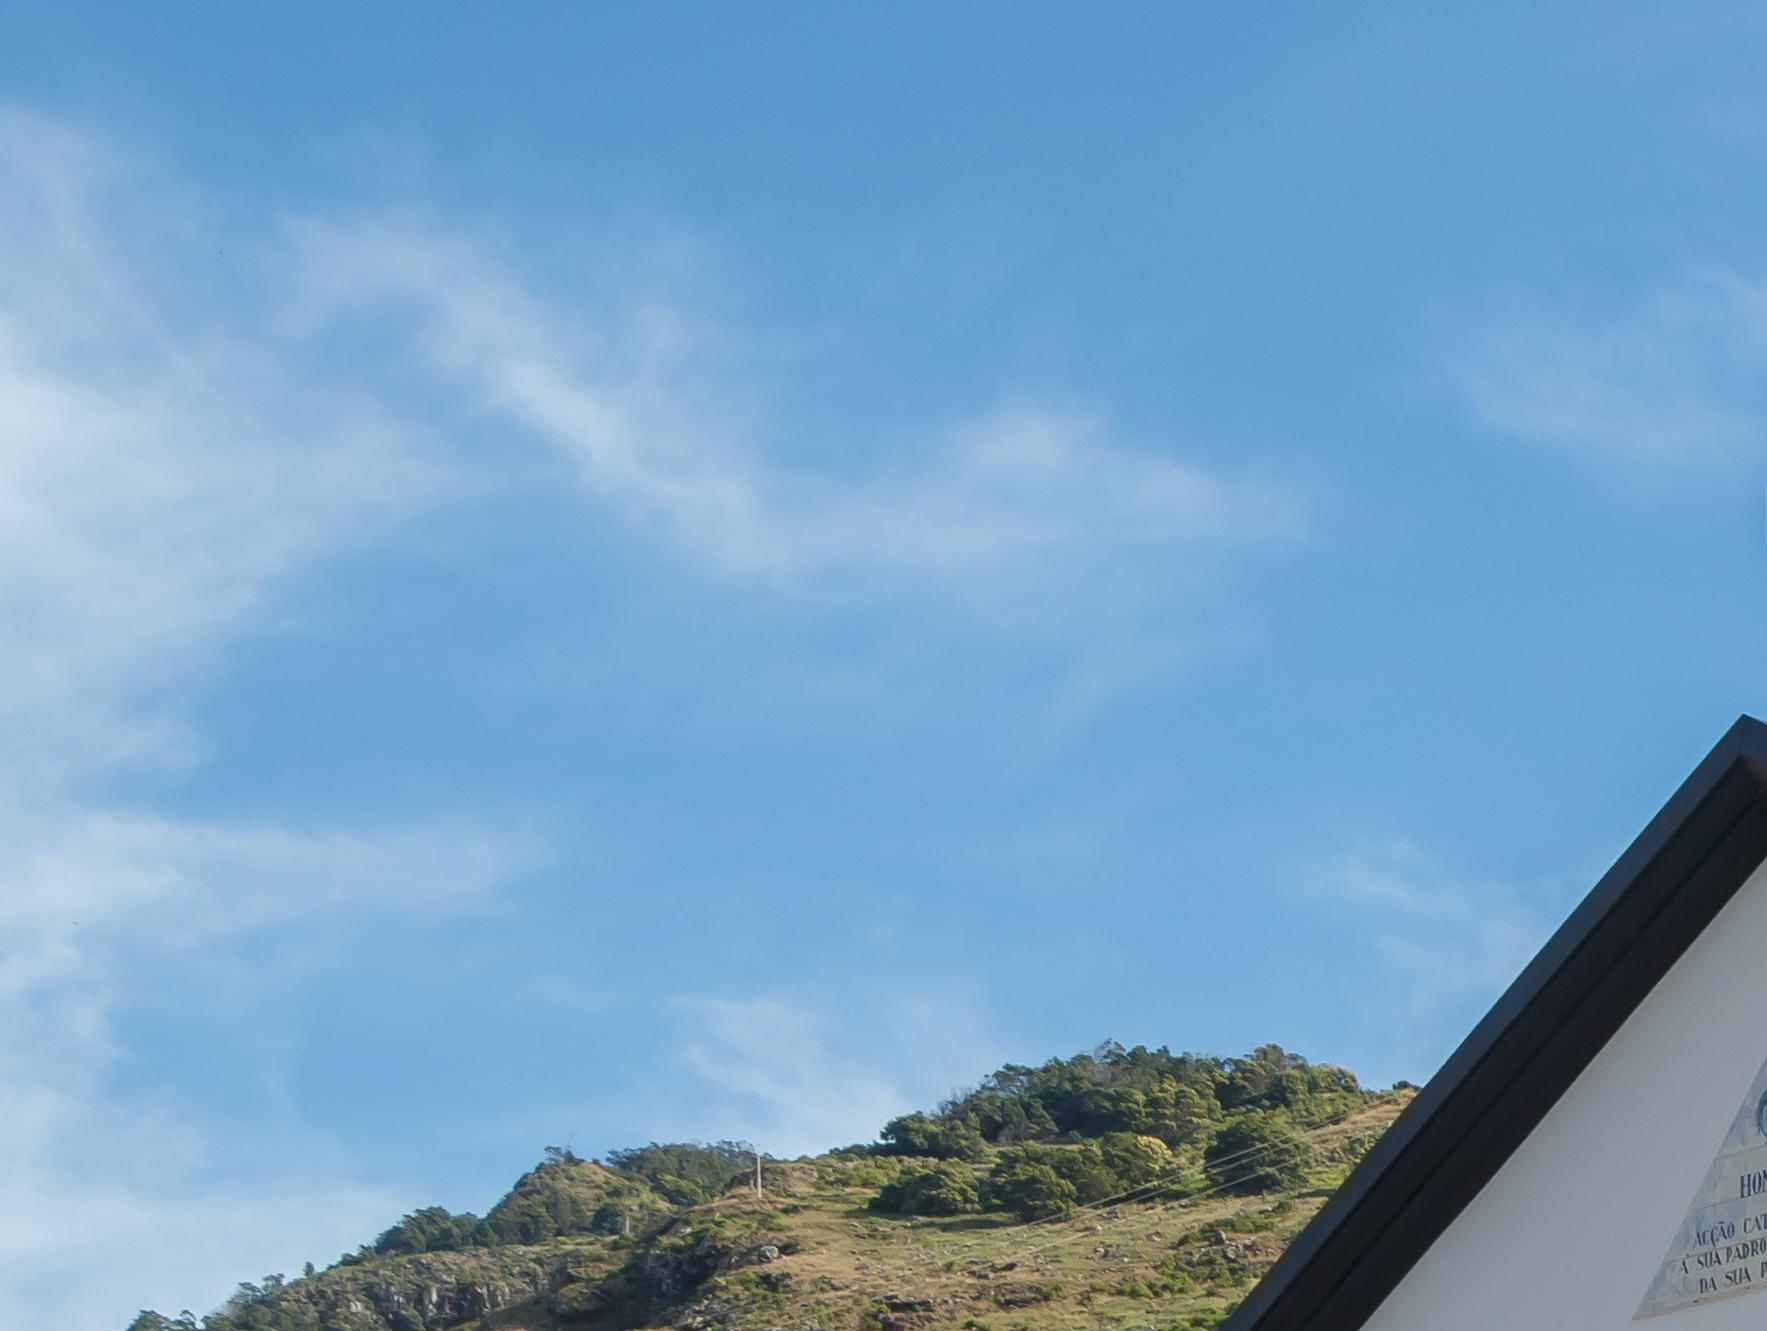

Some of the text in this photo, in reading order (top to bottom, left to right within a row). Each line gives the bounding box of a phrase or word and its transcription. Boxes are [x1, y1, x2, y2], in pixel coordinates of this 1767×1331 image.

[1694, 1221, 1735, 1249] ACÇÃO
[1697, 1249, 1722, 1270] SUA
[1699, 1275, 1717, 1294] DA
[1725, 1266, 1752, 1287] SUA
